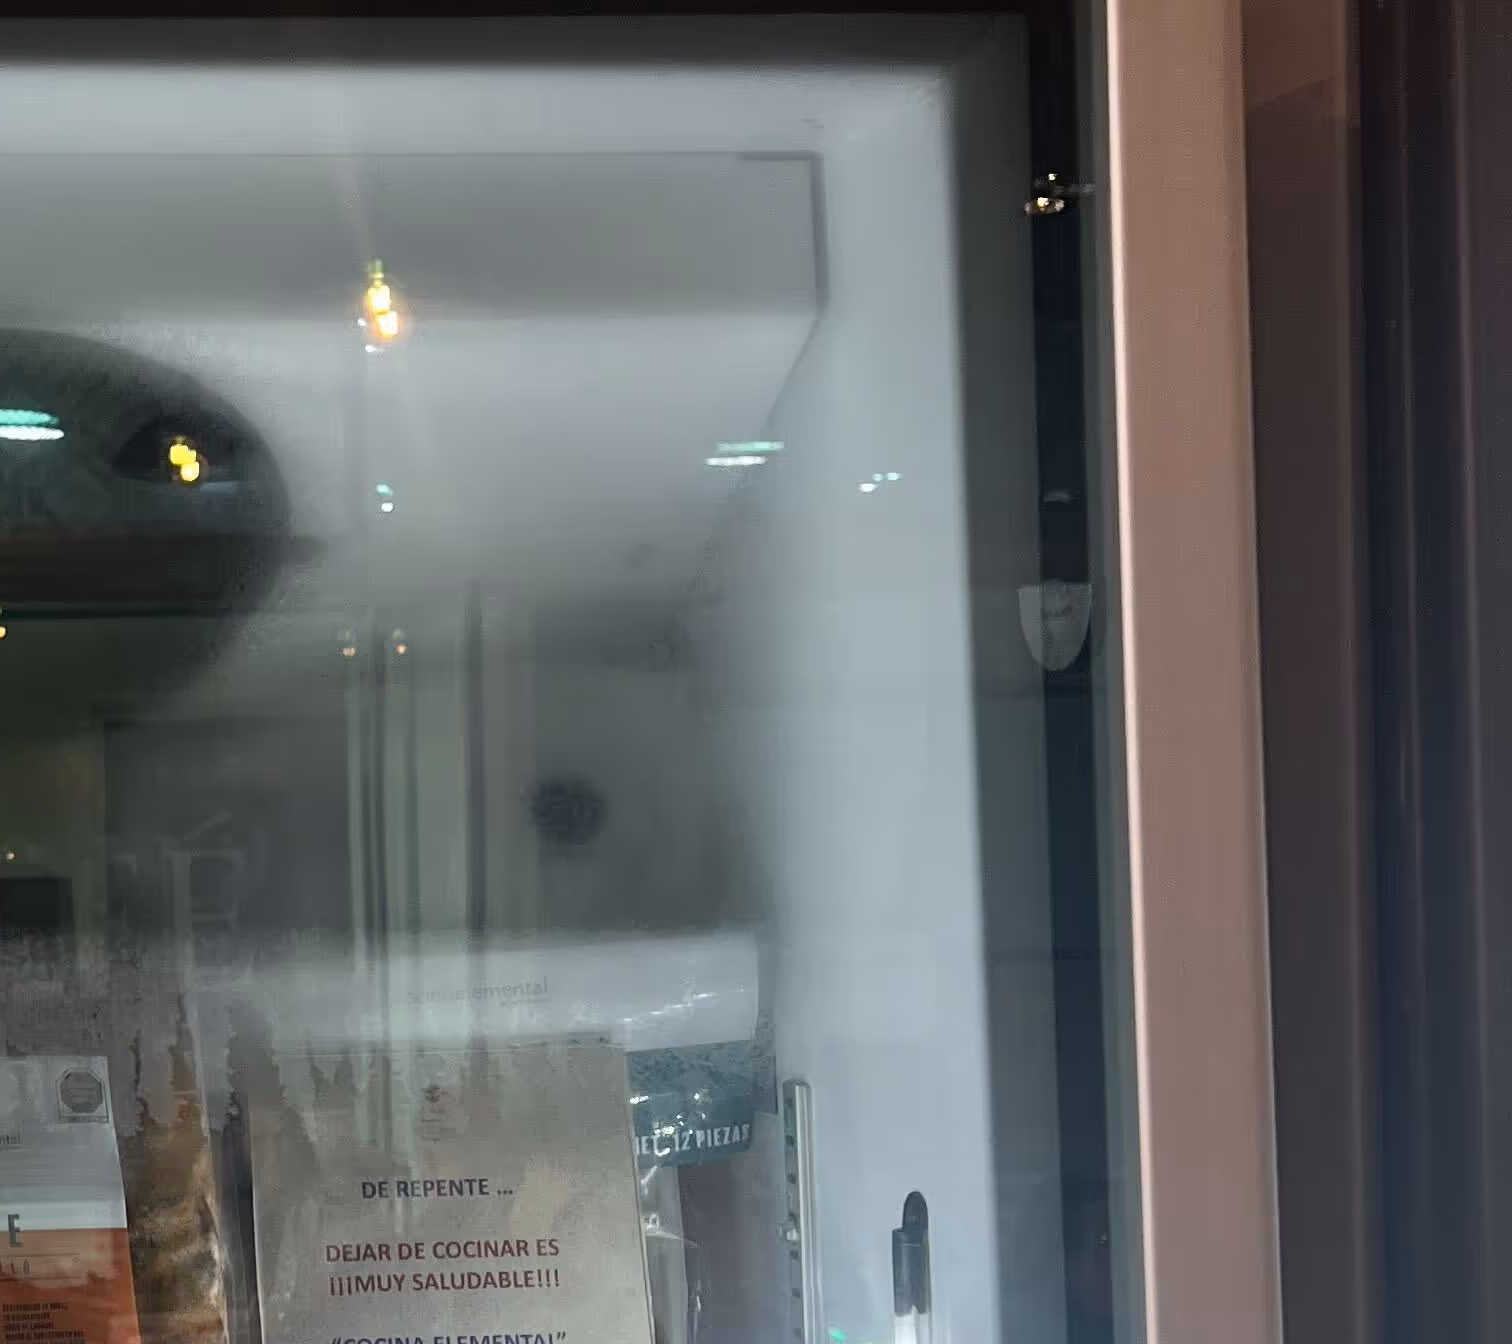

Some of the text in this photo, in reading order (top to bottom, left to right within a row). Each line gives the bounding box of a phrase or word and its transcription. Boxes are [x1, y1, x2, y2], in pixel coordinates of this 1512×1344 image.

[361, 1178, 490, 1199] DE REPENTE
[326, 1238, 560, 1263] DEJAR DE COCINAR ES
[412, 1269, 560, 1291] SALUDABLE!!!
